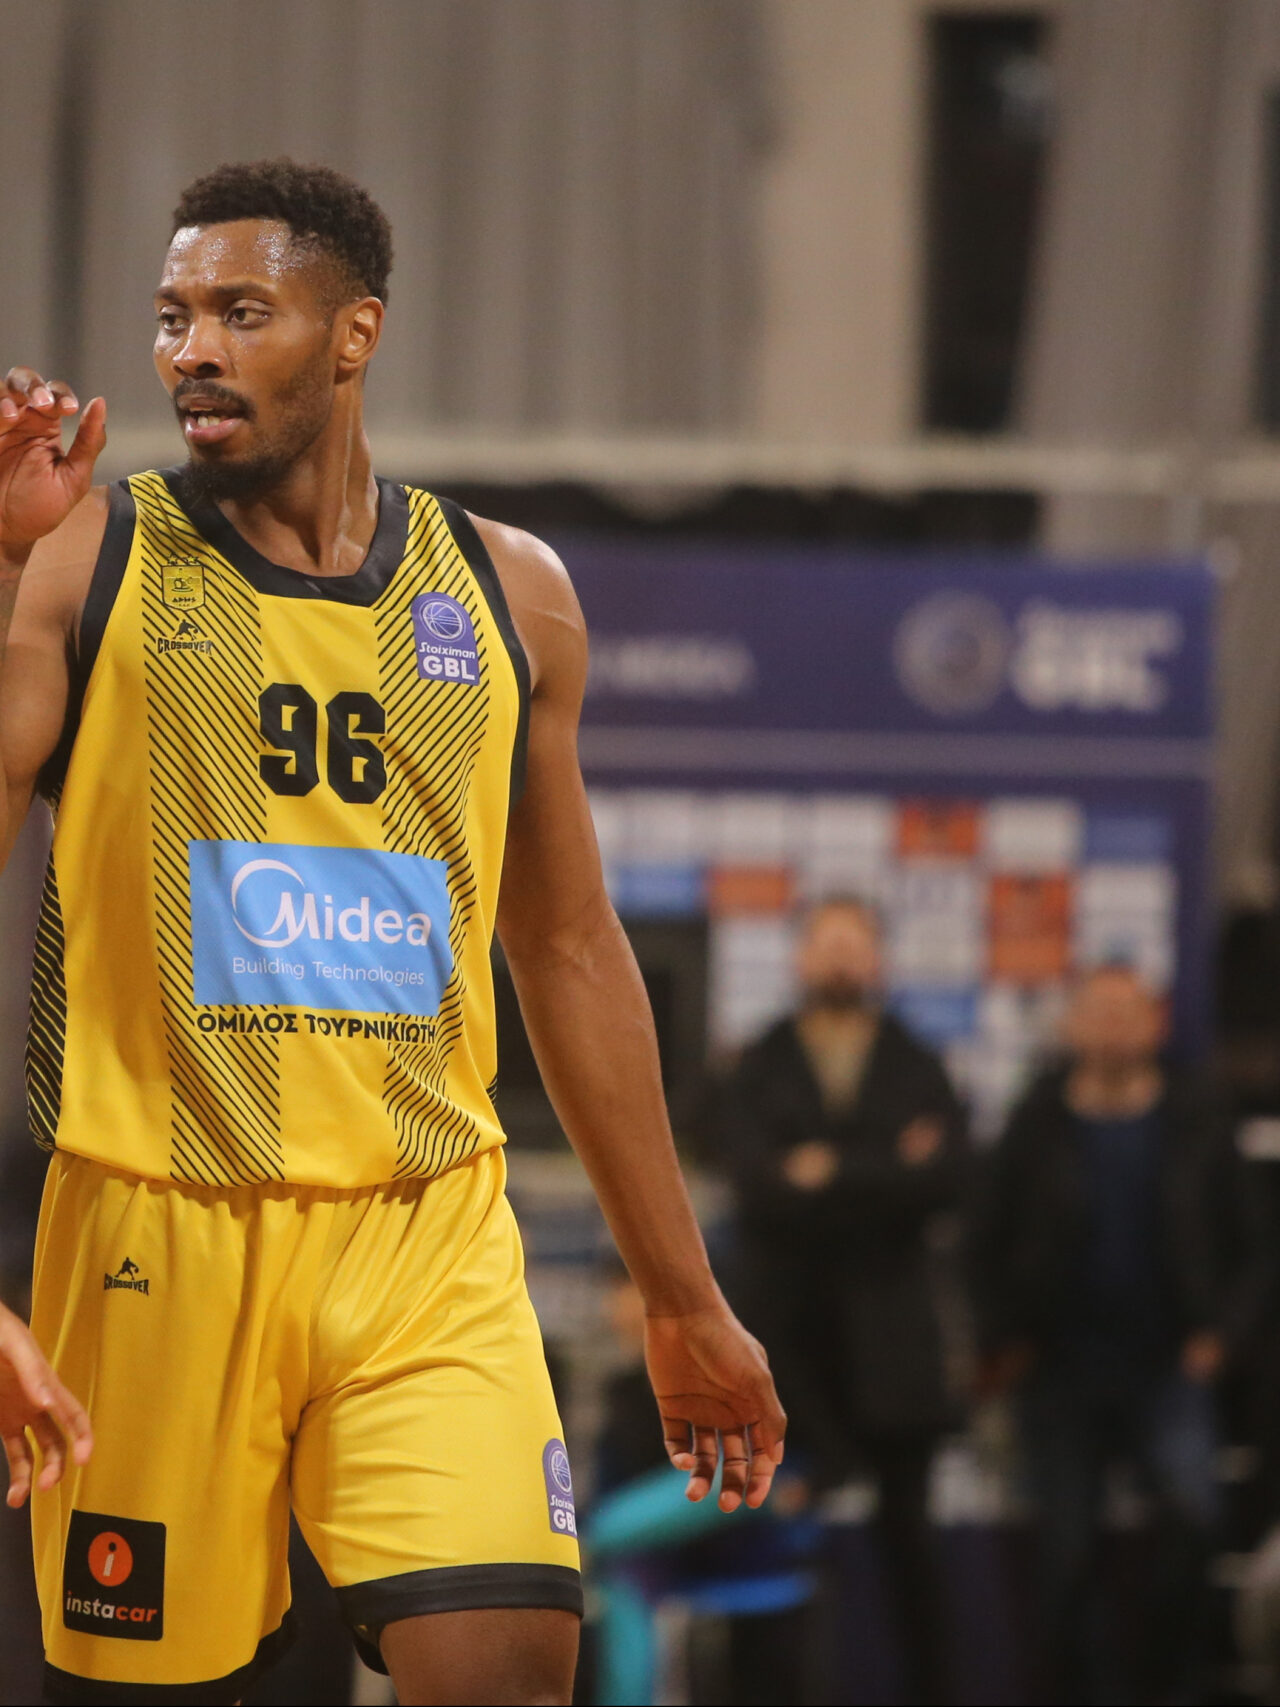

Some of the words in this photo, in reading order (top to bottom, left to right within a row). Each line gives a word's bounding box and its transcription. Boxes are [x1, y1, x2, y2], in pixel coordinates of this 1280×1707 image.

[157, 637, 212, 656] CROSSOVER
[419, 641, 476, 659] Stoiximan
[422, 655, 476, 681] GBL
[257, 682, 388, 805] 96
[263, 891, 432, 947] Midea
[232, 957, 305, 980] Building
[312, 961, 425, 987] Technologies
[197, 1012, 299, 1033] ΟΜΙΛΟΣ
[66, 1590, 158, 1623] instacar
